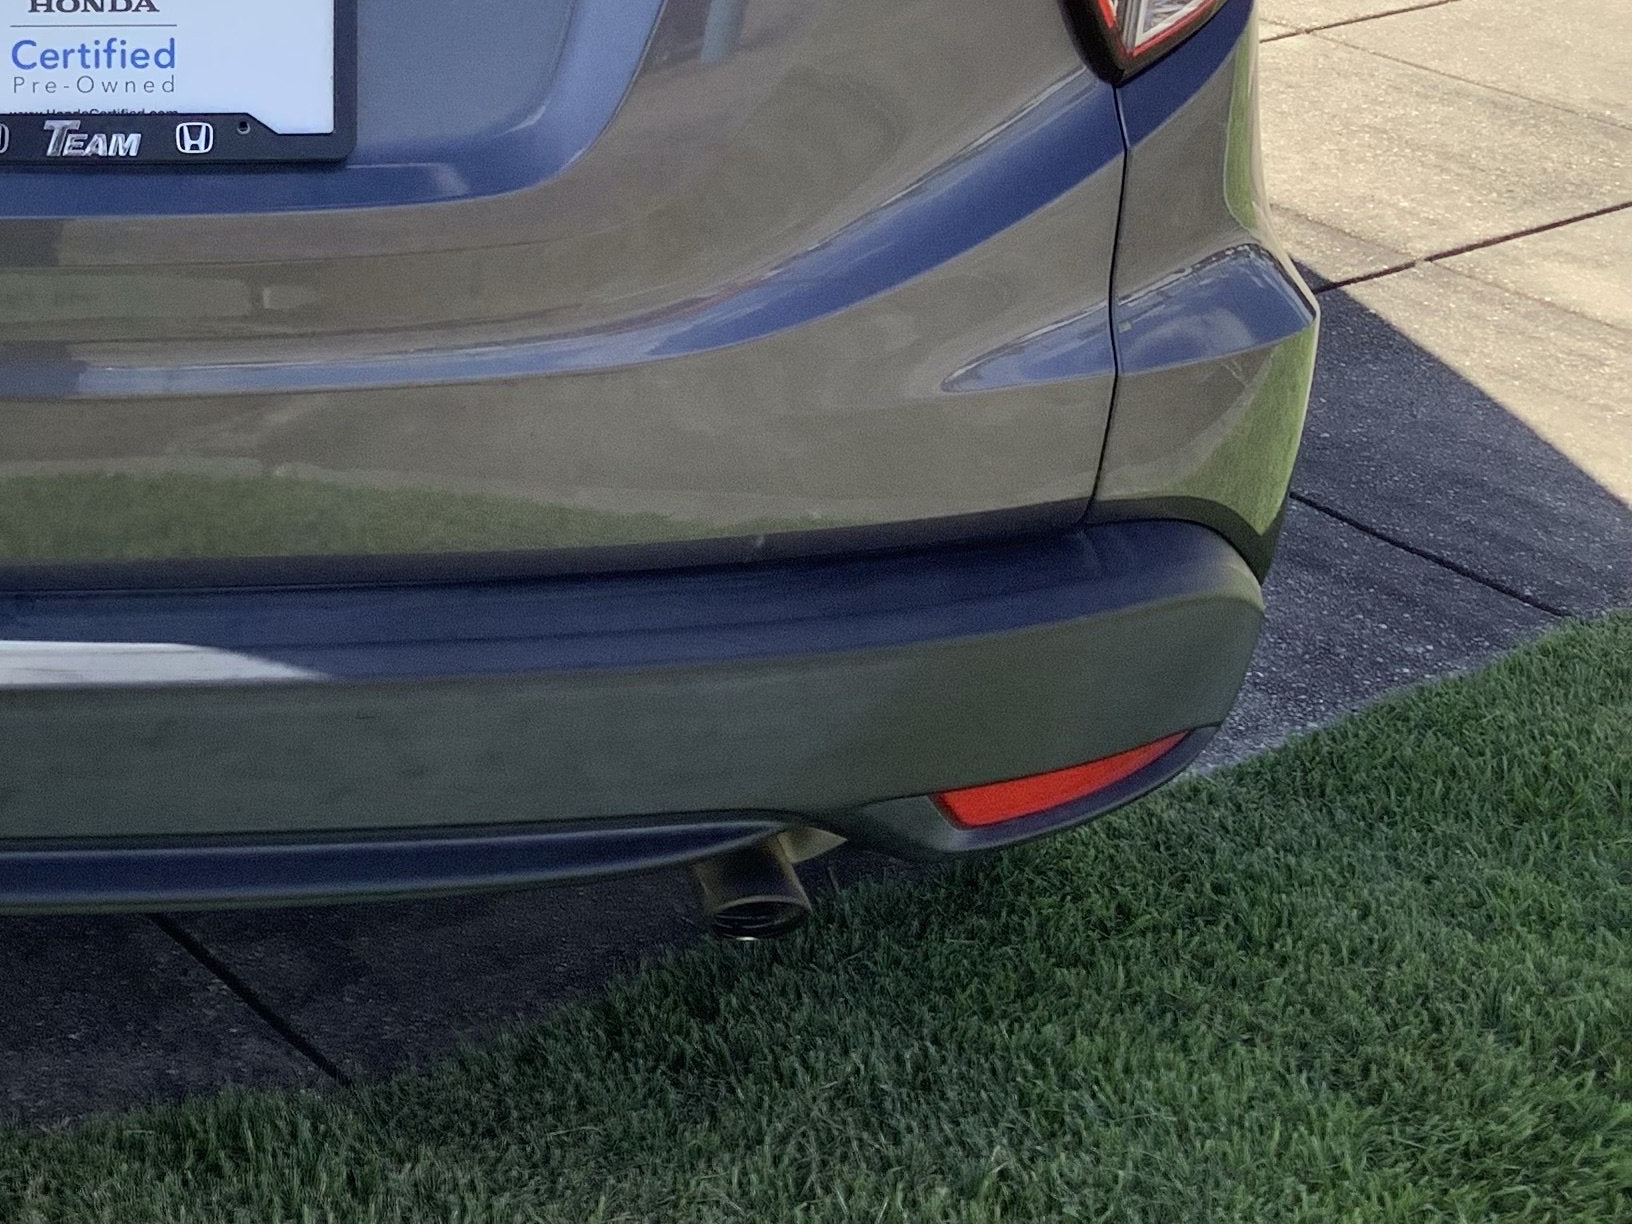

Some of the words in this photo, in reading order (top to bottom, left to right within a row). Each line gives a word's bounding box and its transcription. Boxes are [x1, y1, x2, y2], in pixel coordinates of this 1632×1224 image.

[11, 37, 176, 70] Certified
[13, 74, 175, 94] Pre-Owned
[43, 119, 142, 157] TEAM
